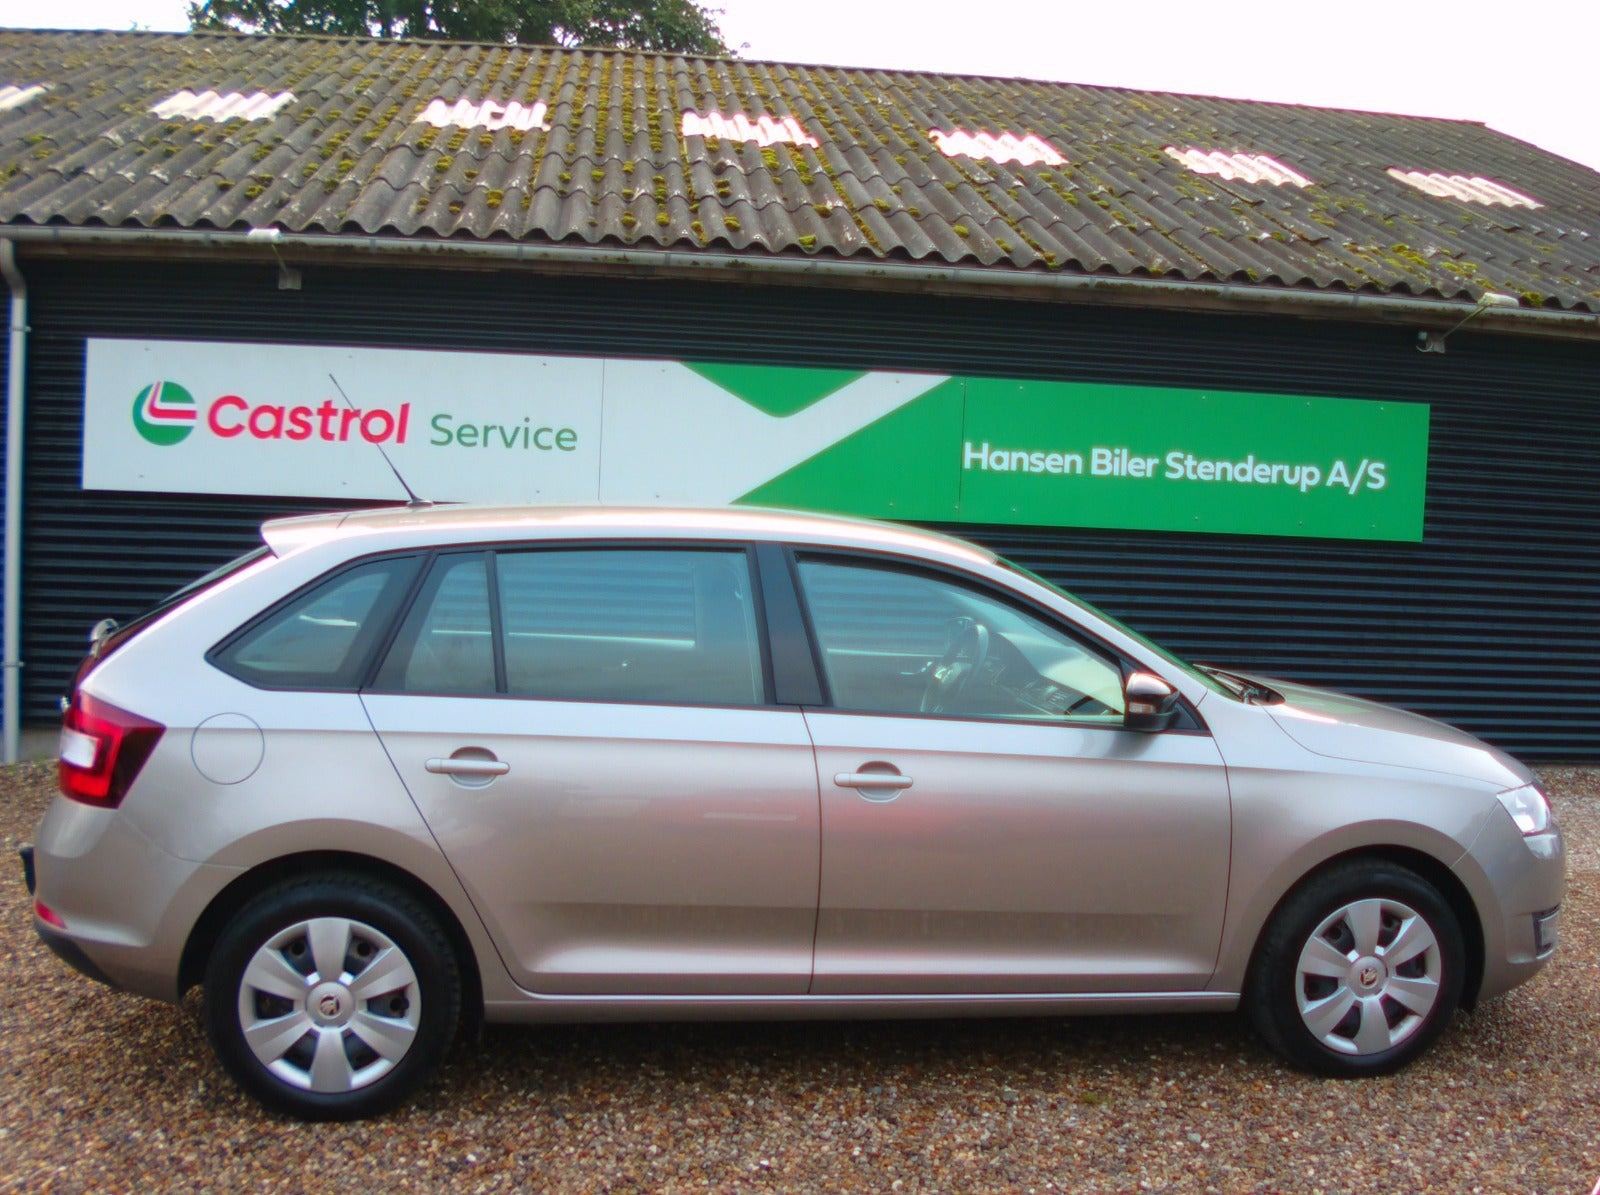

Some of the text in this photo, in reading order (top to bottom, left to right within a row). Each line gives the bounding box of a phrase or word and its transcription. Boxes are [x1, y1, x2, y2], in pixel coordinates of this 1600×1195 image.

[208, 395, 578, 451] Castrol Service
[963, 442, 1386, 495] Hansen Biler Stenderup A/S
